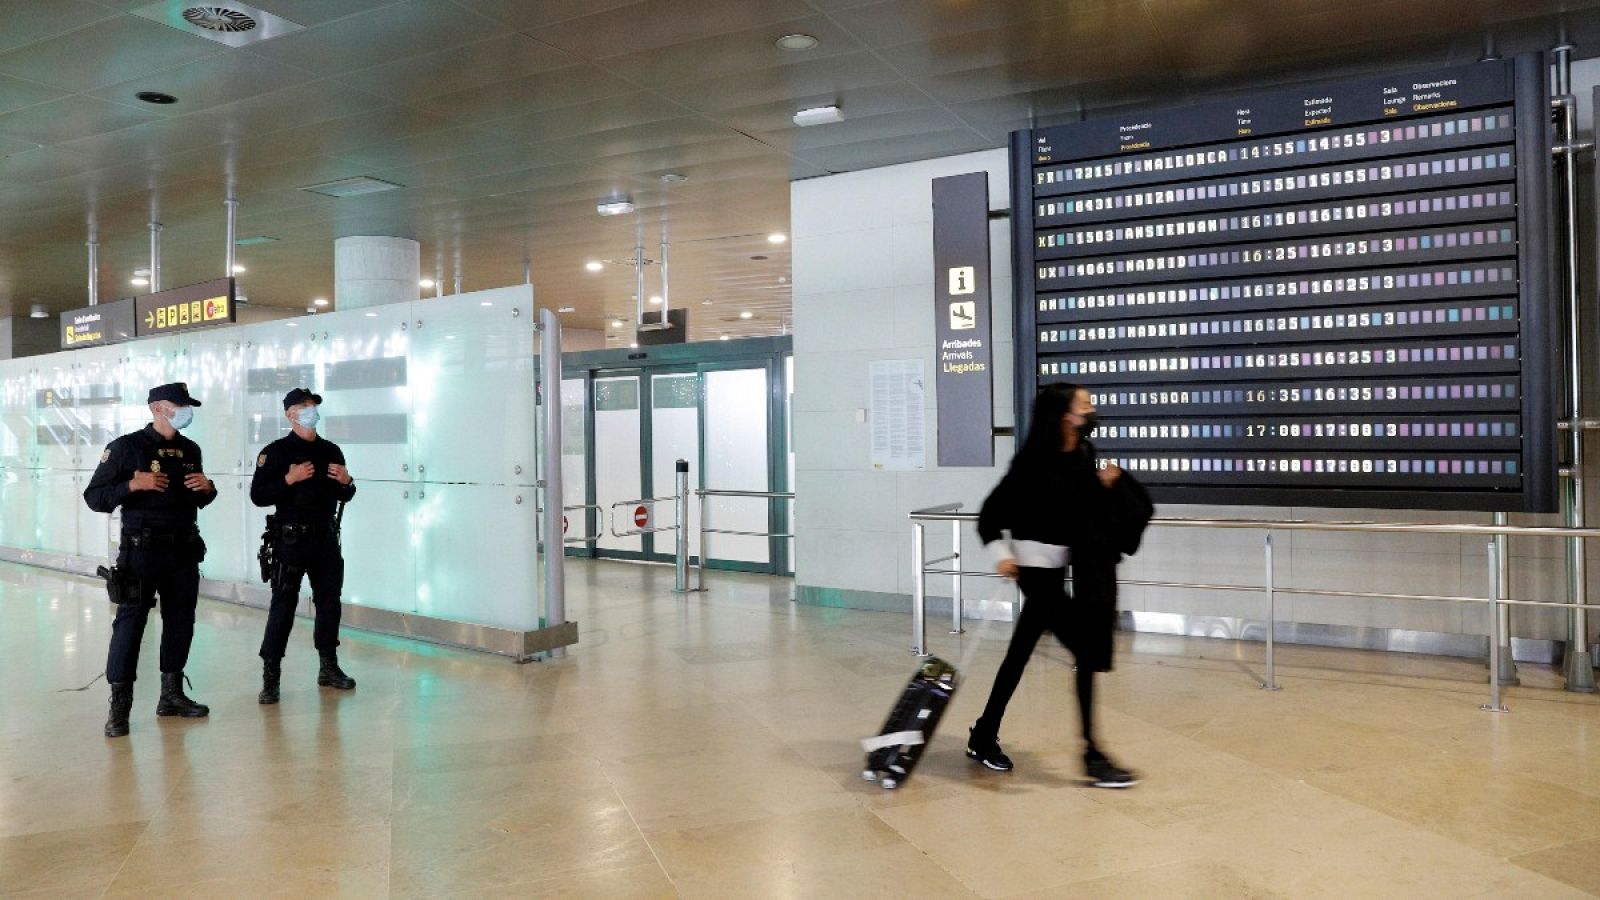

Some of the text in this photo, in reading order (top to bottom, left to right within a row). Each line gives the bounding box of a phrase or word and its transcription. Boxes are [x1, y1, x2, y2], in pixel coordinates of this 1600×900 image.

[1240, 142, 1294, 160] 14:55
[1308, 133, 1365, 151] 14:55
[1380, 130, 1390, 143] 3
[1039, 203, 1056, 217] IB
[1125, 190, 1174, 207] IBIZA
[1241, 176, 1295, 195] 15:55
[1308, 169, 1366, 188] 15:55
[1381, 166, 1391, 180] 3
[1125, 219, 1217, 240] AMSTERDAM
[1241, 212, 1295, 229] 16:10
[1308, 205, 1367, 223] 16:10
[1381, 203, 1392, 216] 3
[1039, 267, 1057, 280] UX
[1126, 255, 1186, 273] MADRID
[1243, 246, 1297, 263] 16:25
[1311, 240, 1368, 257] 16:25
[1382, 239, 1393, 252] 3
[1127, 290, 1187, 306] MADRID
[1243, 282, 1297, 298] 16:25
[1311, 277, 1369, 294] 16:25
[1383, 275, 1394, 289] 3
[1127, 323, 1188, 338] MADRID
[1243, 316, 1299, 332] 16:25
[1312, 313, 1370, 329] 16:25
[1384, 312, 1394, 325] 3
[942, 339, 982, 349] Arribades
[942, 350, 973, 361] Arrivals
[1128, 357, 1189, 371] MADRID
[1245, 353, 1299, 368] 16:25
[1313, 350, 1371, 366] 16:25
[1386, 349, 1396, 363] 3
[943, 361, 985, 374] Llegadas
[1129, 391, 1190, 405] LISBOA
[1246, 388, 1300, 402] 16:35
[1314, 387, 1372, 401] 16:35
[1386, 386, 1397, 399] 3
[1129, 425, 1190, 438] MADRID
[1245, 423, 1300, 437] 17:00
[1314, 423, 1372, 437] 17:00
[1386, 423, 1397, 437] 3
[1129, 458, 1190, 471] MADRID
[1246, 459, 1301, 472] 17:00
[1314, 459, 1373, 472] 17:00
[1387, 459, 1397, 472] 3
